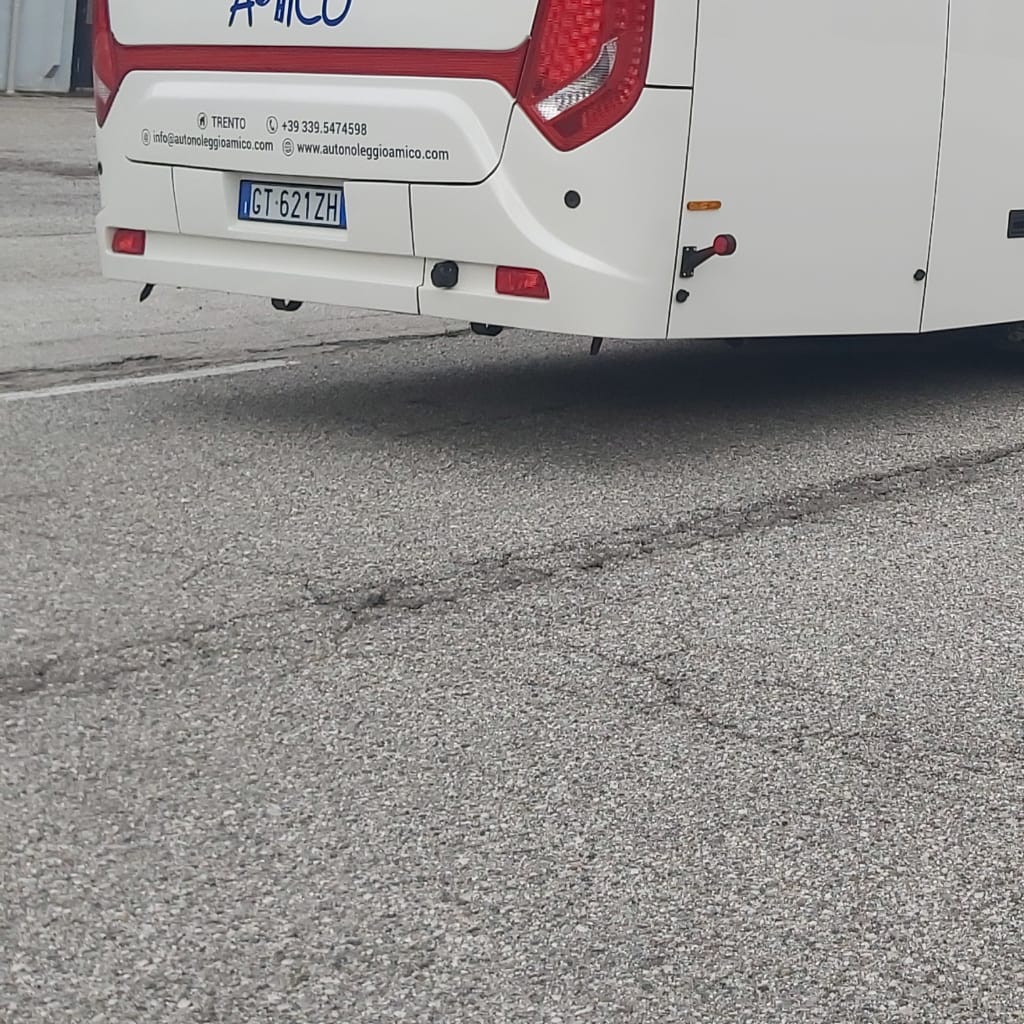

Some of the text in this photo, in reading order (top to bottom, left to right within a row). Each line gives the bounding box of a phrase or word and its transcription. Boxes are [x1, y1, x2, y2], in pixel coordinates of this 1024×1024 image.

[211, 115, 246, 130] TRENTO
[281, 119, 368, 136] +39 339.5474598
[152, 130, 274, 152] info@autonoleggioamico.com
[296, 142, 450, 161] www.autonoleggioamico.com
[252, 187, 338, 222] GT 621ZH
